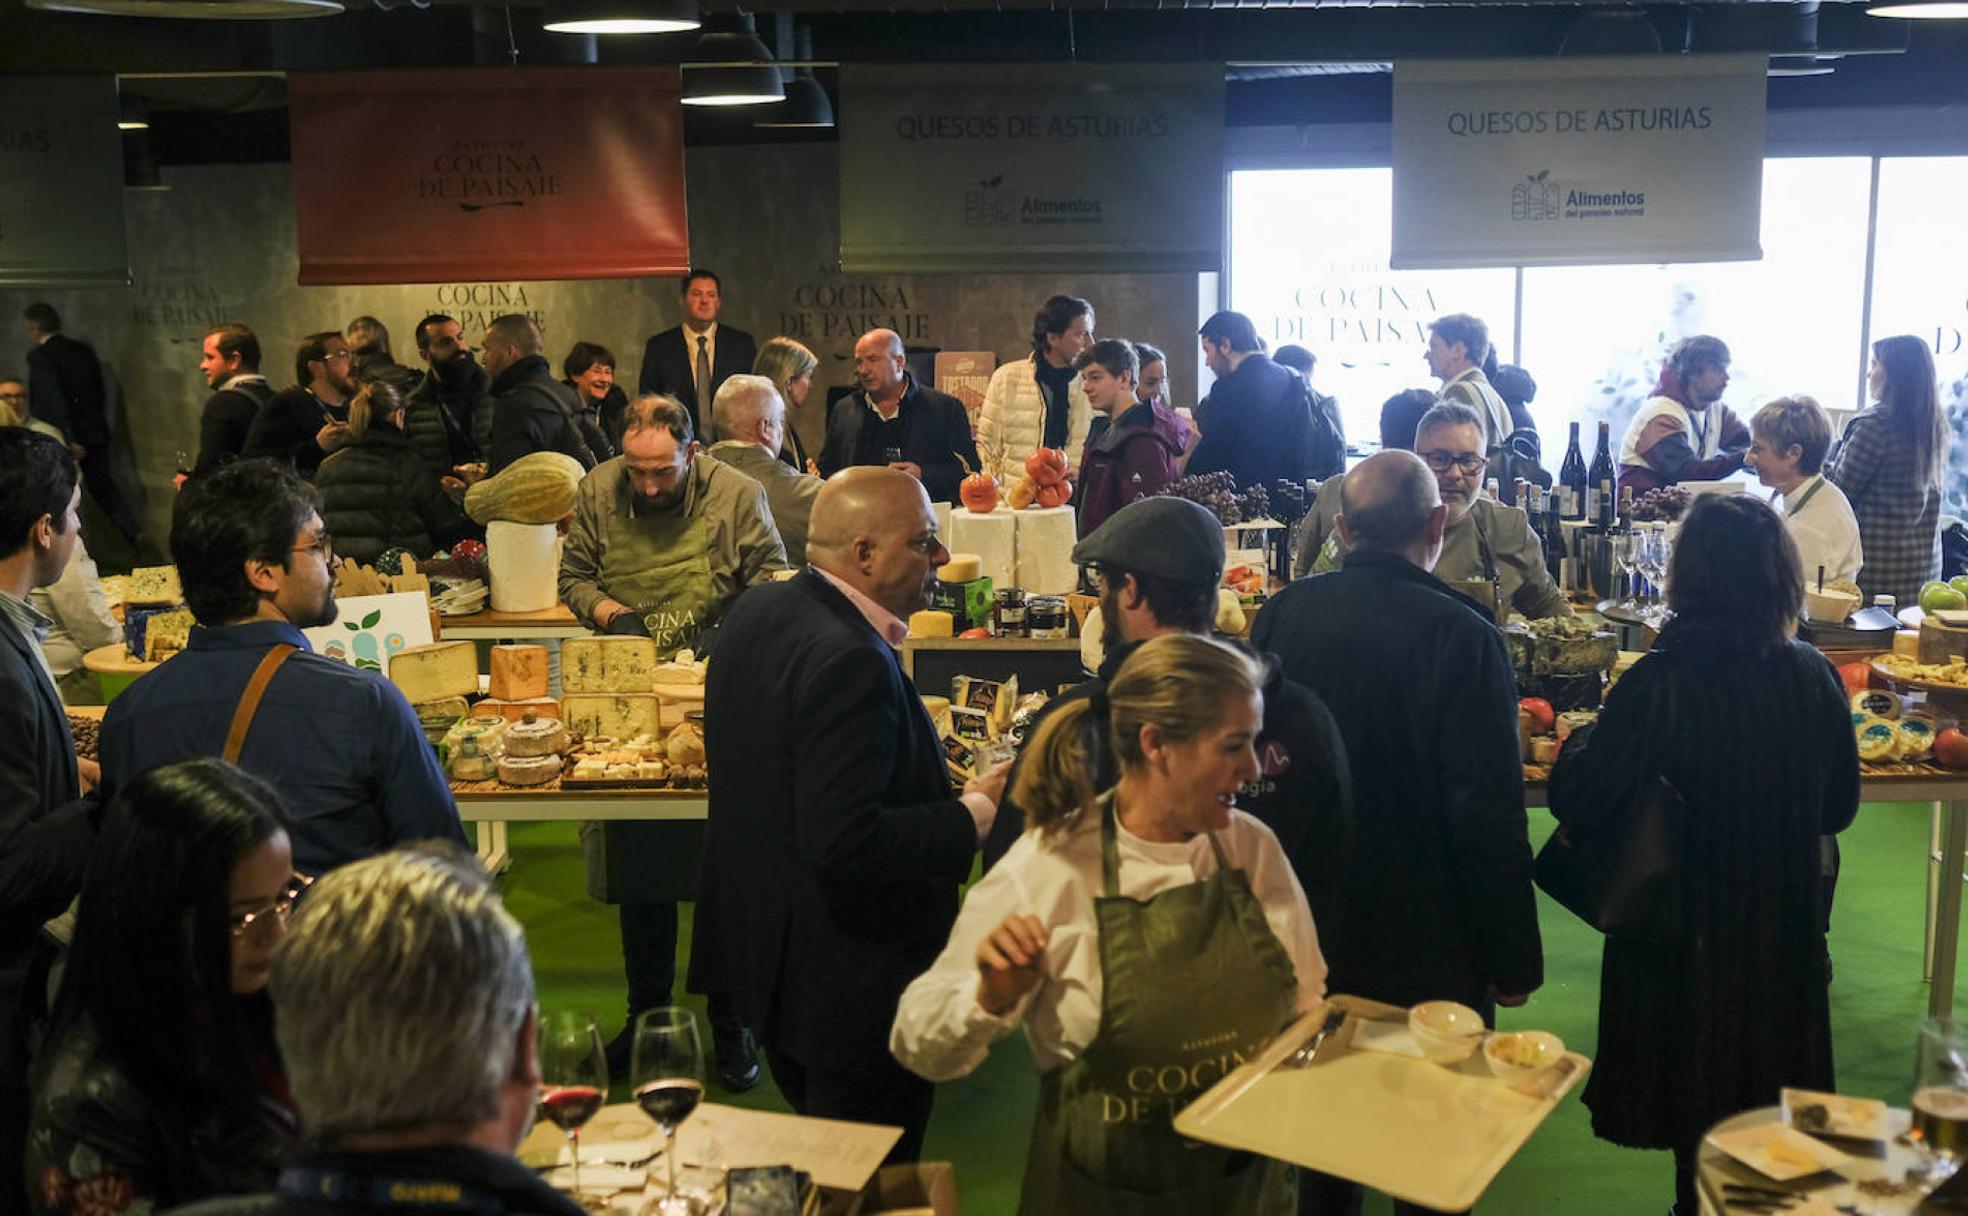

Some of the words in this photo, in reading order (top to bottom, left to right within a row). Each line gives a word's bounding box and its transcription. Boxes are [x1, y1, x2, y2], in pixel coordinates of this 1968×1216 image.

[896, 115, 1000, 141] QUESOS
[1007, 115, 1040, 138] DE
[1047, 115, 1168, 138] ASTURIAS
[1447, 110, 1548, 136] QUESOS
[1556, 111, 1586, 132] DE
[1594, 107, 1712, 131] ASTURIAS
[432, 152, 541, 174] COCINA
[418, 175, 450, 198] DE
[1566, 189, 1645, 206] Alimentos
[1021, 196, 1103, 214] Alimentos
[437, 284, 529, 306] COCINA
[795, 284, 910, 309] COCINA
[1295, 285, 1438, 311] COCINA
[780, 313, 813, 338] DE
[1103, 1094, 1151, 1122] DE
